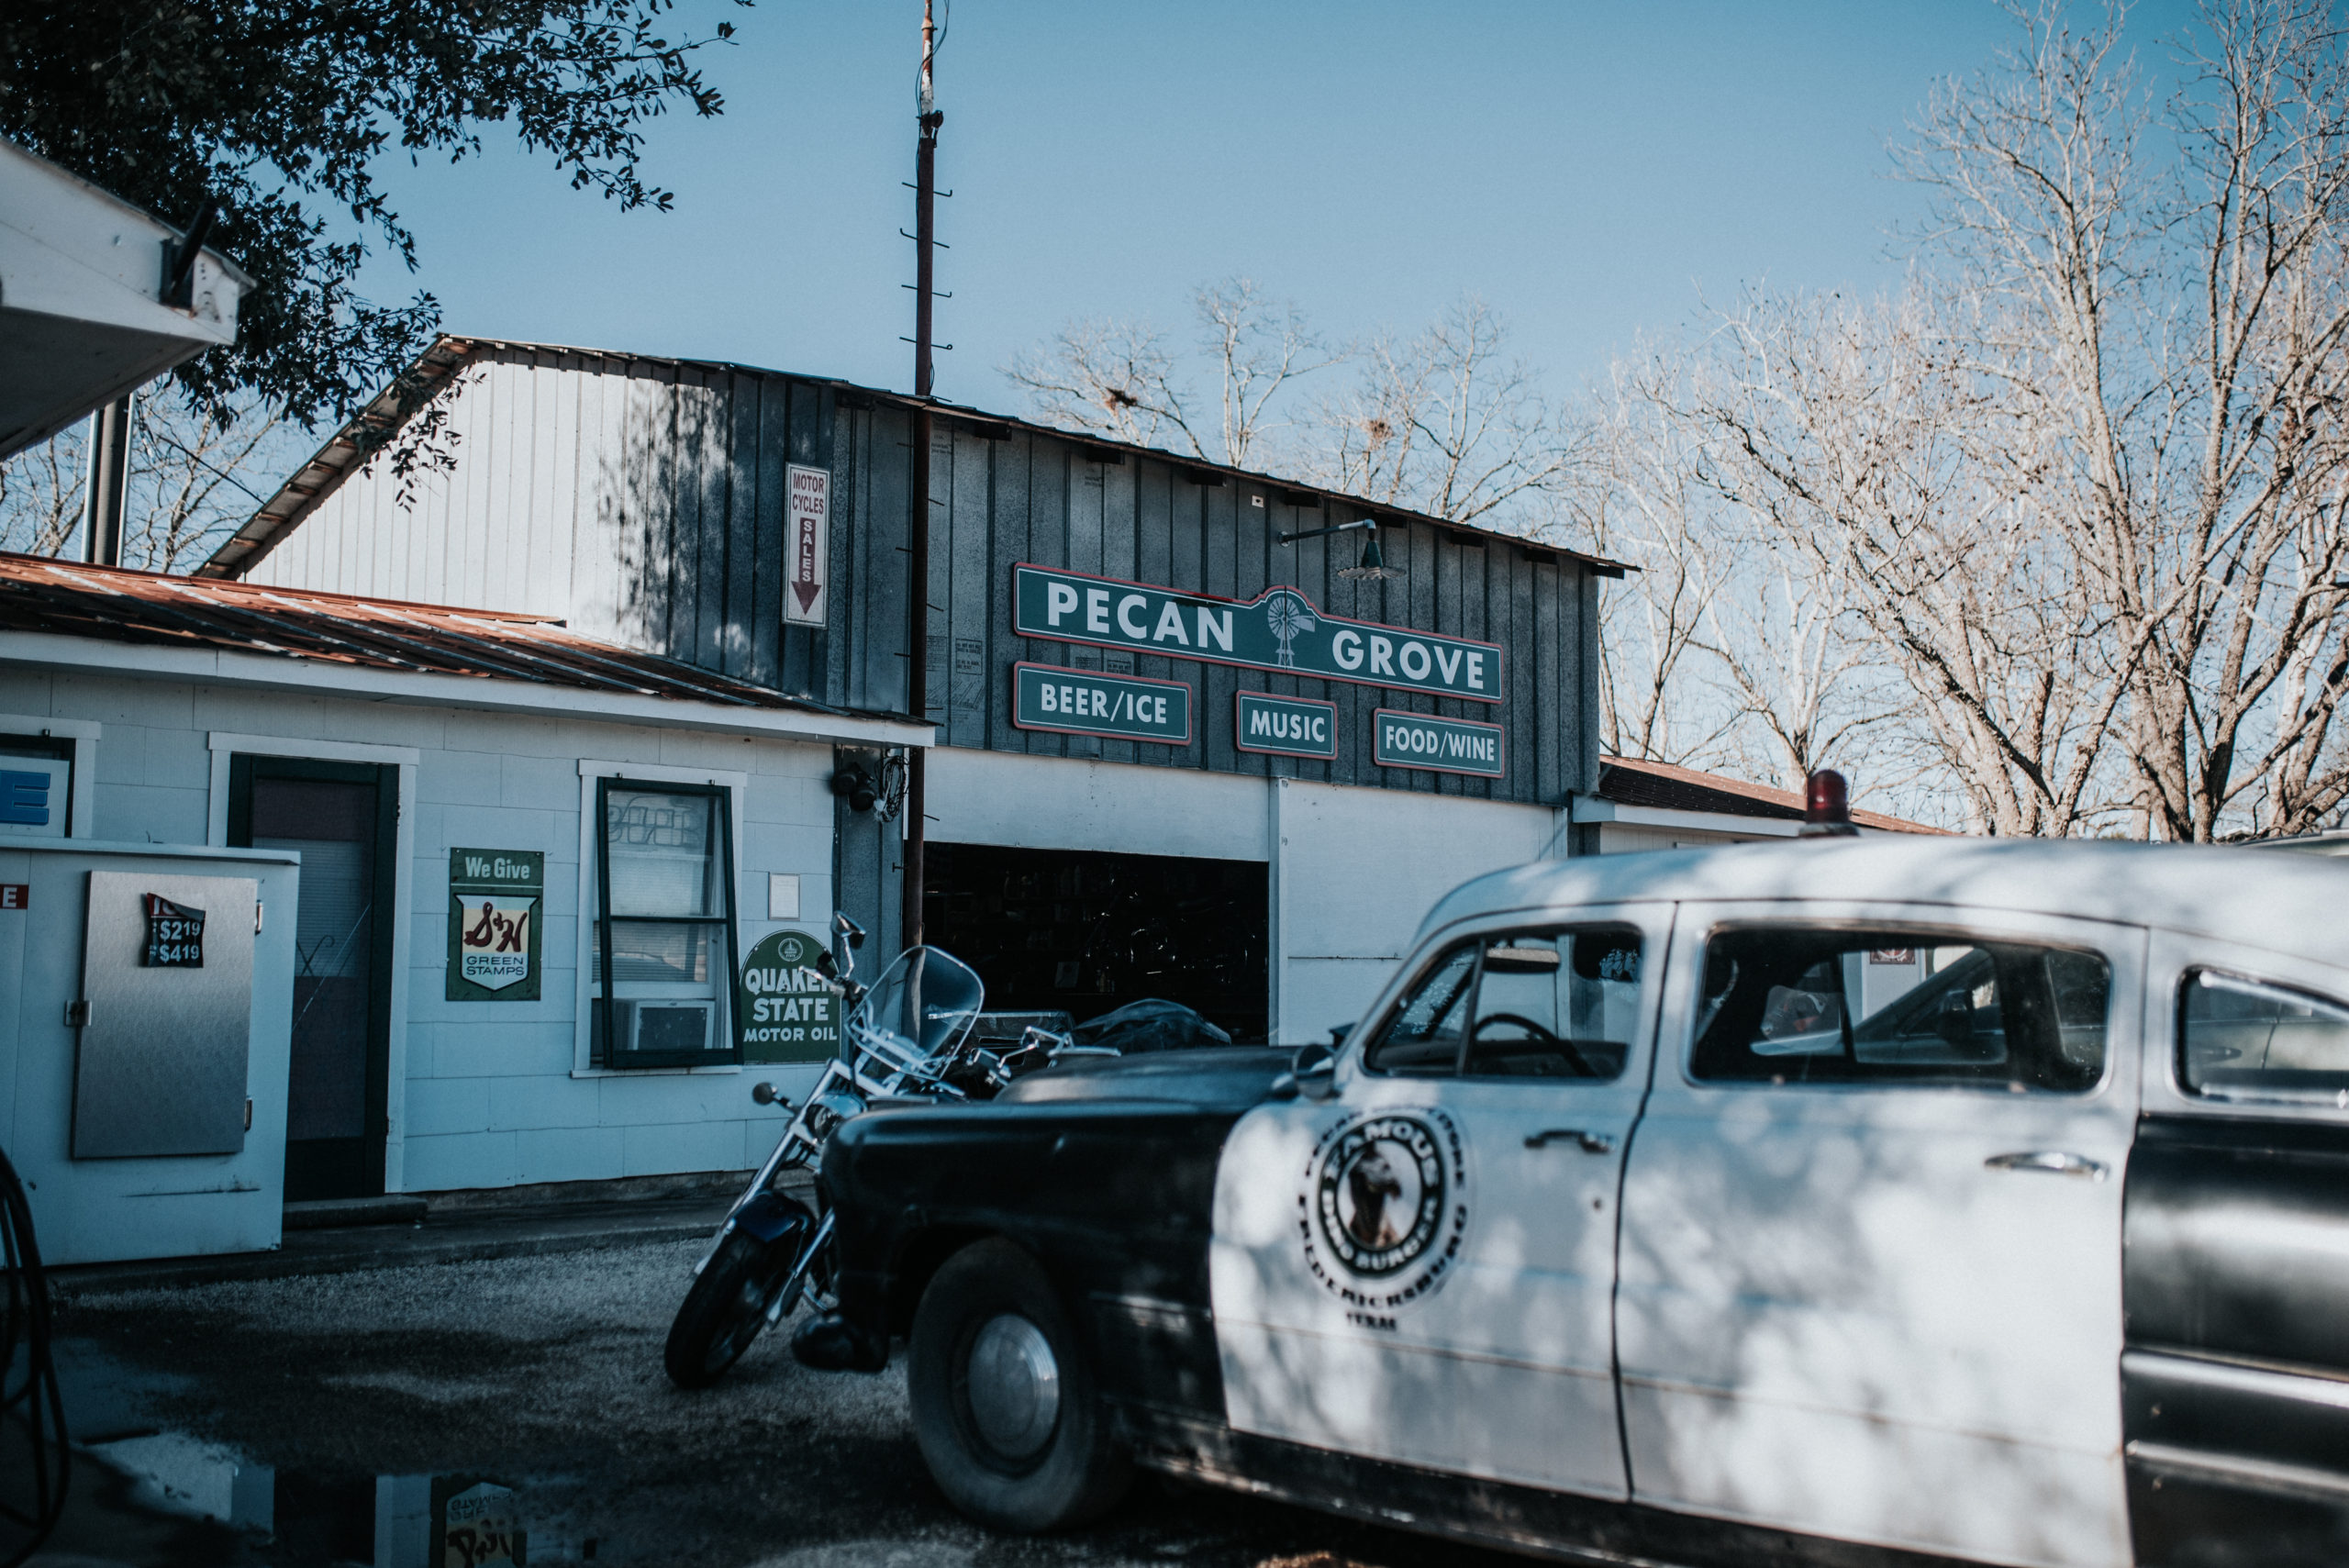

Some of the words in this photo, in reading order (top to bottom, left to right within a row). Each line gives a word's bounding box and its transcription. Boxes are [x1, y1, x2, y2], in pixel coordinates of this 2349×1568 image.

[793, 473, 824, 495] MOTOR
[792, 493, 824, 516] CYCLES
[802, 520, 813, 583] SALES
[1048, 581, 1233, 652] PECAN
[1331, 629, 1484, 690] GROVE
[1041, 683, 1167, 725] BEER/ICE
[1250, 709, 1325, 743] MUSIC
[1386, 725, 1495, 762] FOOD/WINE
[465, 856, 491, 877] We
[494, 857, 530, 880] Give
[160, 920, 201, 941] $219
[159, 944, 200, 963] $419
[466, 956, 524, 965] GREEN
[466, 966, 524, 975] STAMPS
[745, 968, 838, 995] QUAKE
[752, 997, 829, 1022] STATE
[743, 1028, 805, 1042] MOTOR
[810, 1027, 838, 1040] OIL
[1324, 1119, 1440, 1187] FAMOUS
